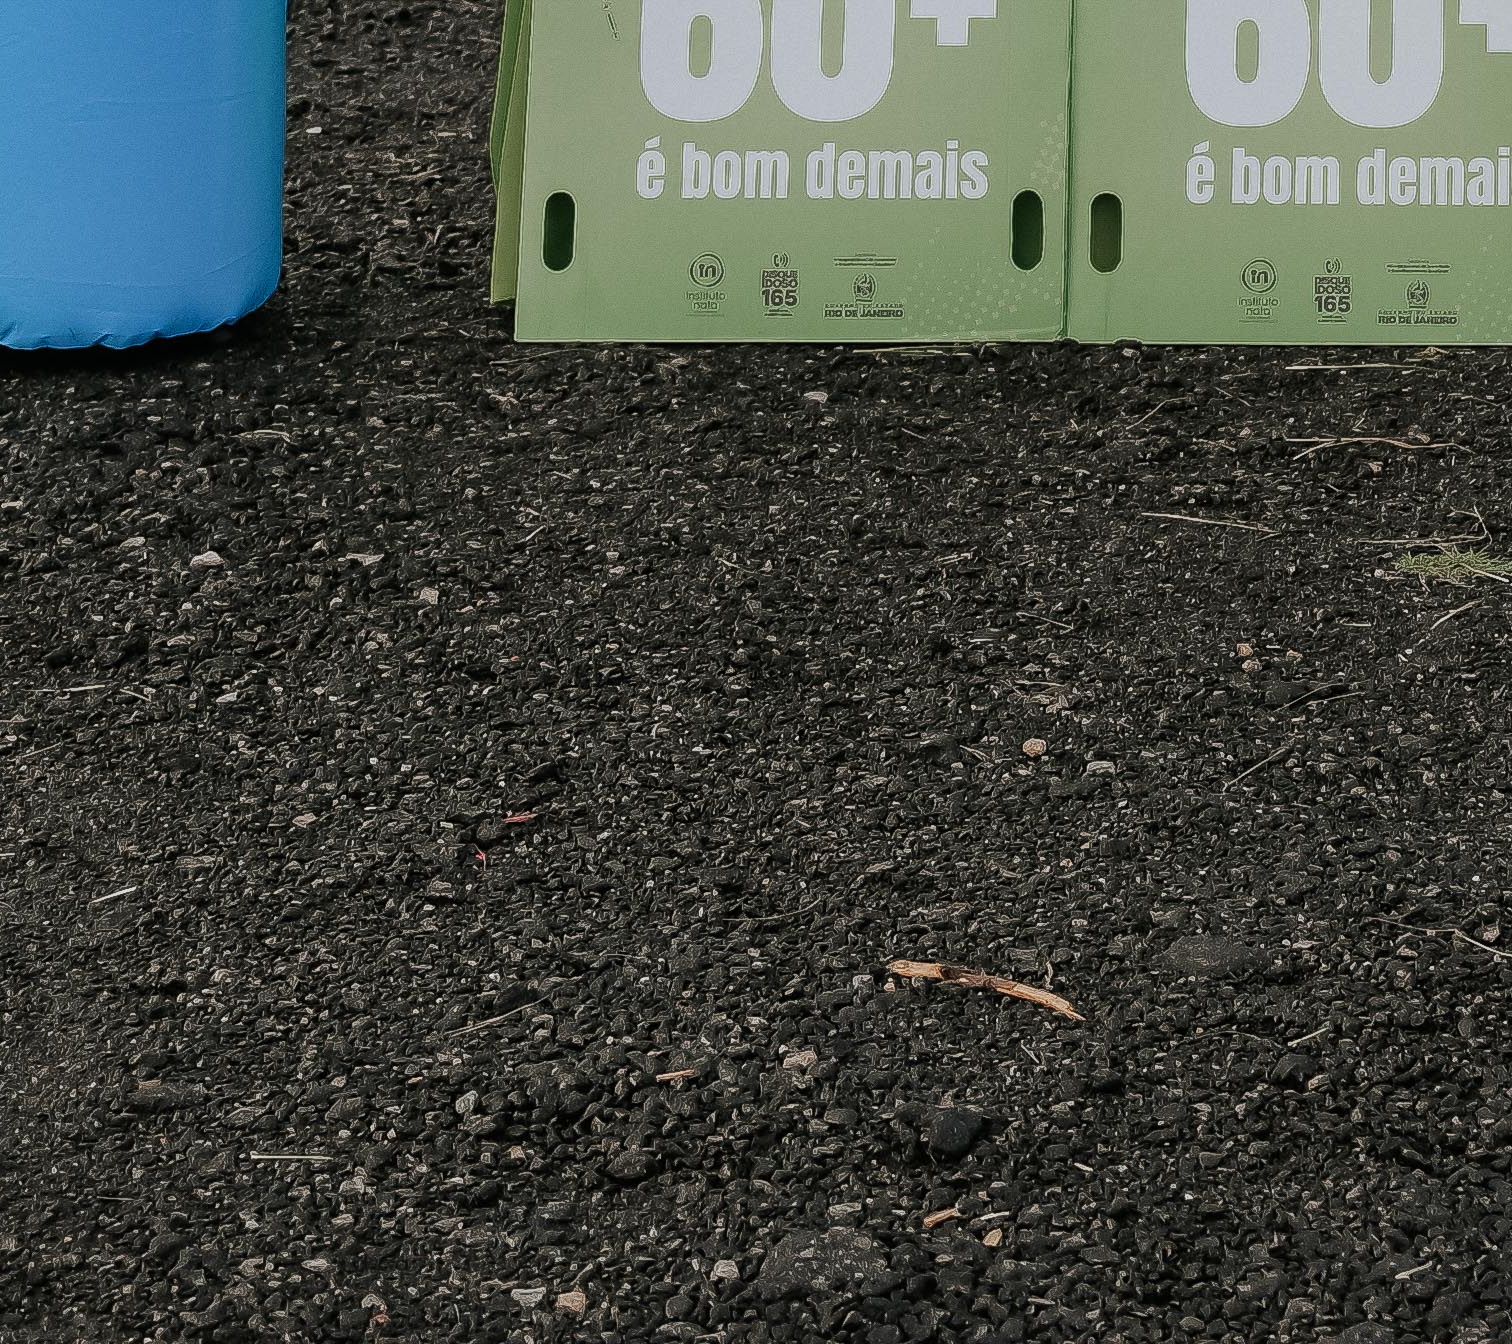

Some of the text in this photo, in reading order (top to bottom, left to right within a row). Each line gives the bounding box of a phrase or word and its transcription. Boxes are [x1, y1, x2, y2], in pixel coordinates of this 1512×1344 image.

[636, 135, 990, 201] é bom demais
[1185, 141, 1215, 206] é
[1231, 146, 1342, 206] bom
[1250, 269, 1269, 284] in
[762, 289, 798, 307] 165
[1314, 295, 1351, 313] 165
